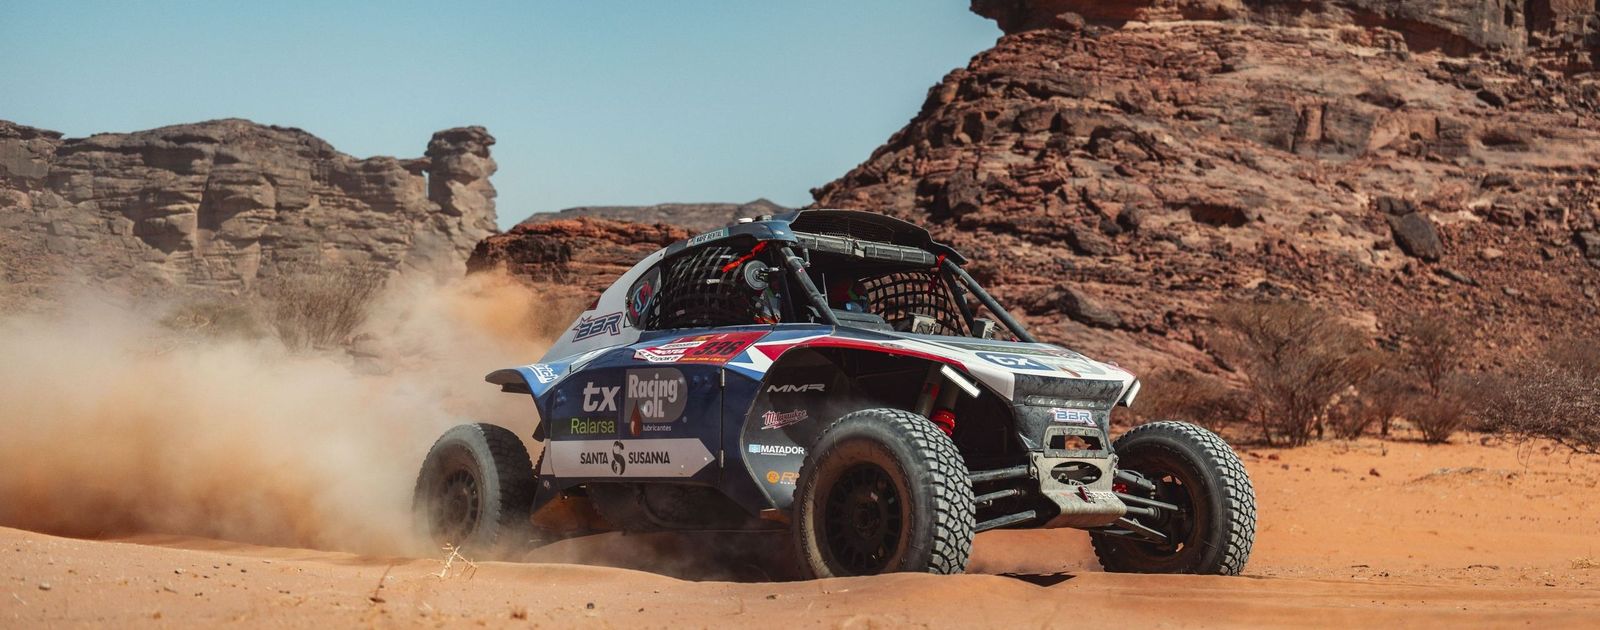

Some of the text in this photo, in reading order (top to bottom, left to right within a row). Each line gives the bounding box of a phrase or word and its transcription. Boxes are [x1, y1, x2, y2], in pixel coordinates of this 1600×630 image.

[574, 313, 623, 341] BBR
[628, 373, 678, 403] Racing
[766, 384, 825, 393] MMR
[583, 382, 620, 412] tx
[1053, 410, 1096, 425] BBR
[570, 418, 615, 435] Ralarsa
[580, 451, 671, 465] SANTA SUSANNA
[761, 445, 805, 455] MATADOR
